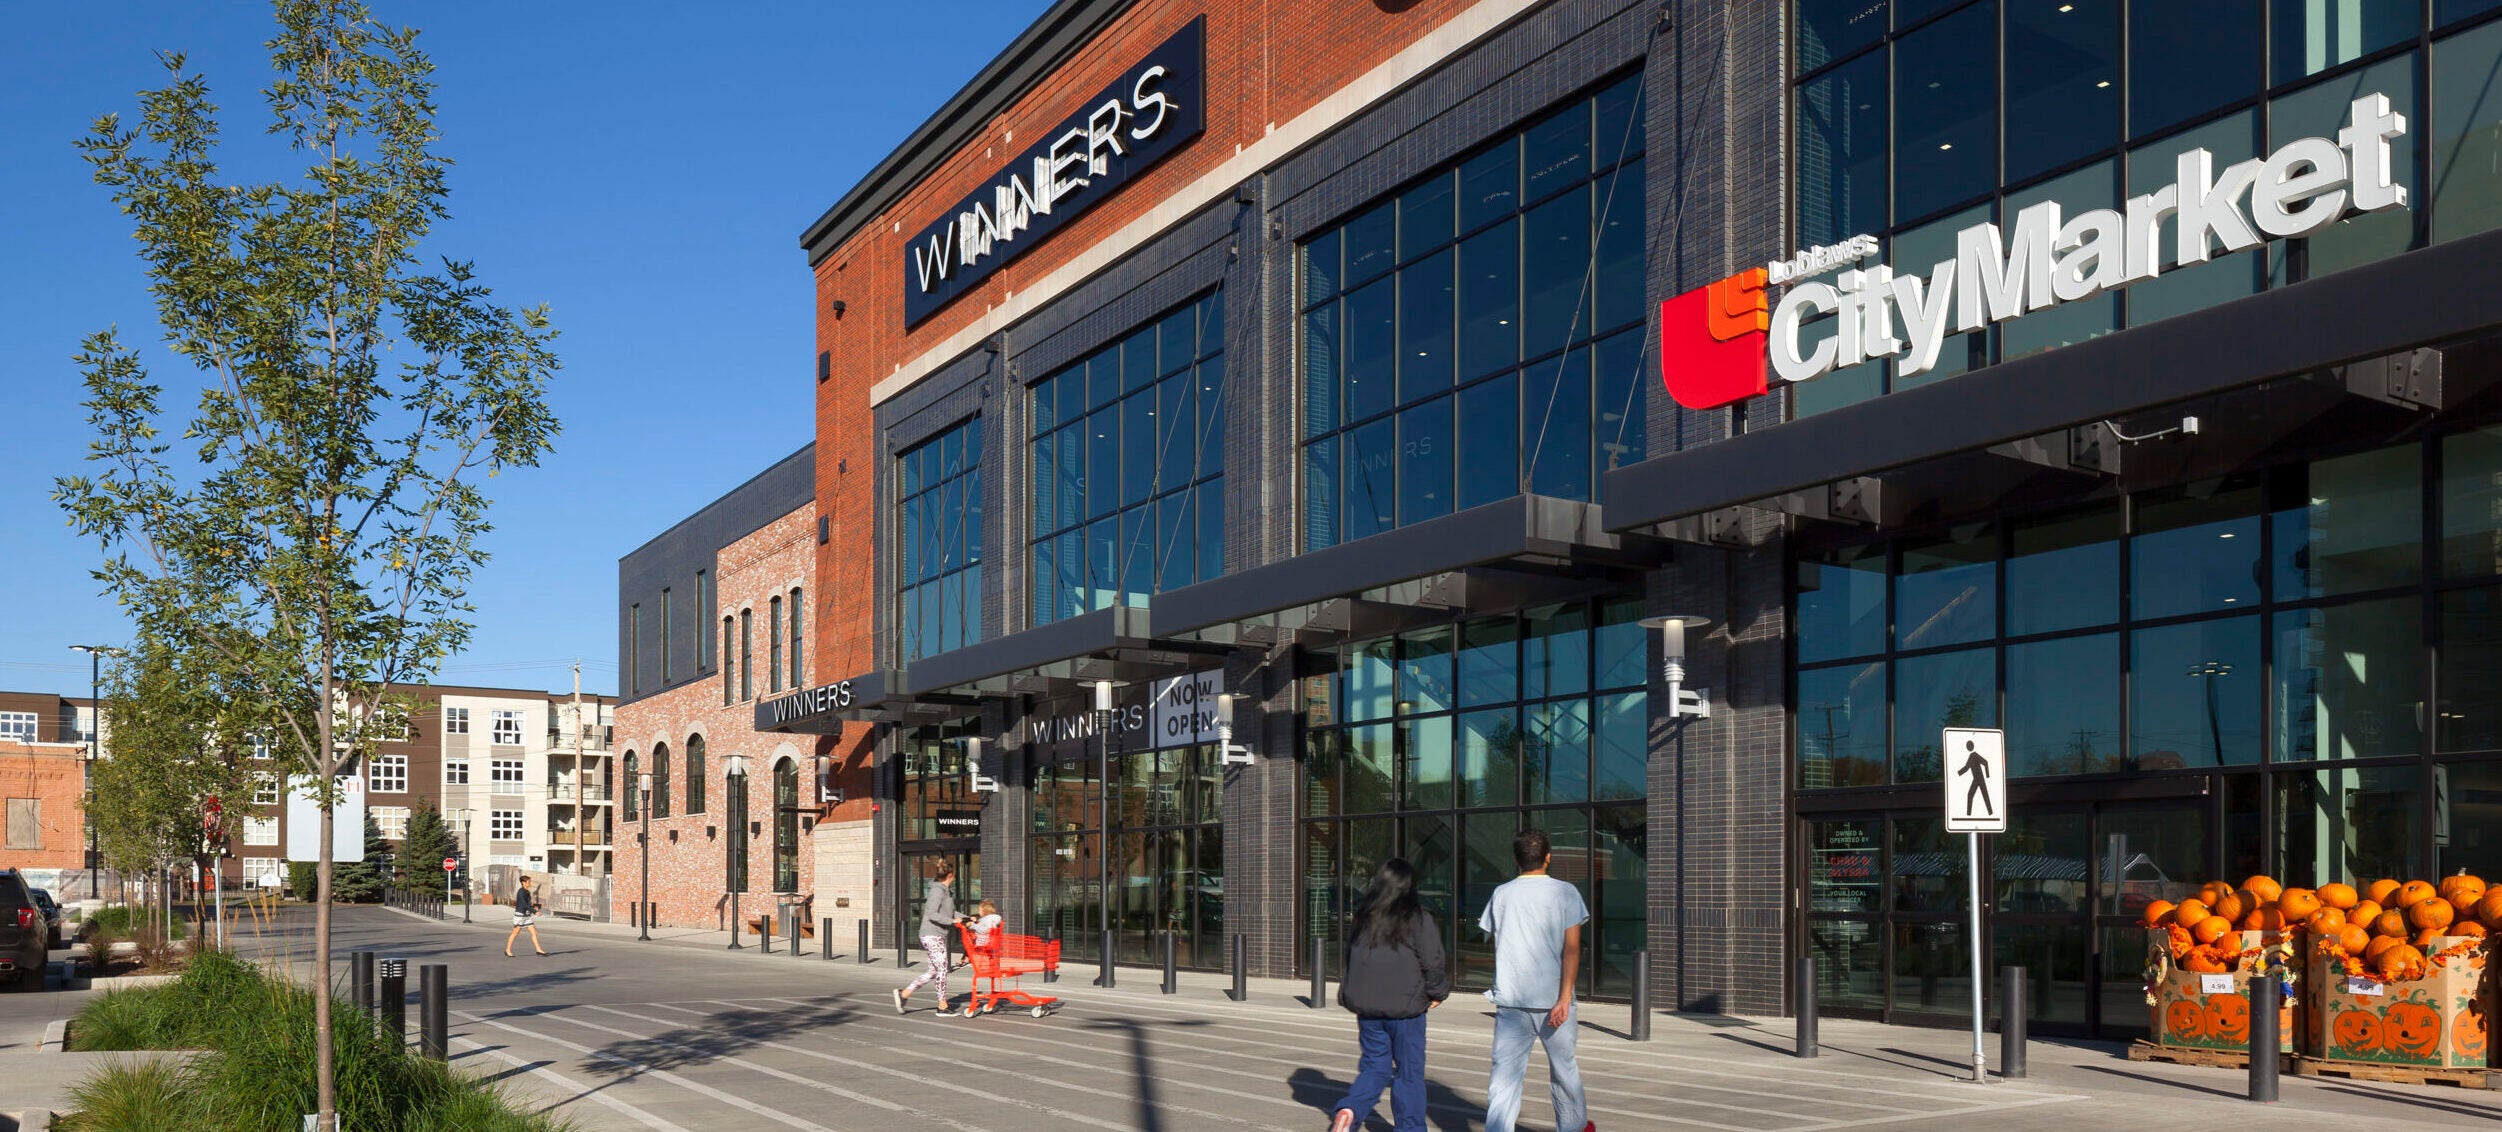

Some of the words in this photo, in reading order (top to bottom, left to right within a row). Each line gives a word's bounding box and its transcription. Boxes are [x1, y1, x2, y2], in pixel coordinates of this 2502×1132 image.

[915, 65, 1166, 293] WINNERS
[1768, 234, 1879, 285] Loblaws
[773, 680, 851, 723] WINNERS
[1170, 679, 1213, 707] NOW
[1033, 704, 1143, 744] WINNRS
[1168, 709, 1213, 737] OPEN
[938, 818, 979, 826] WINNERS
